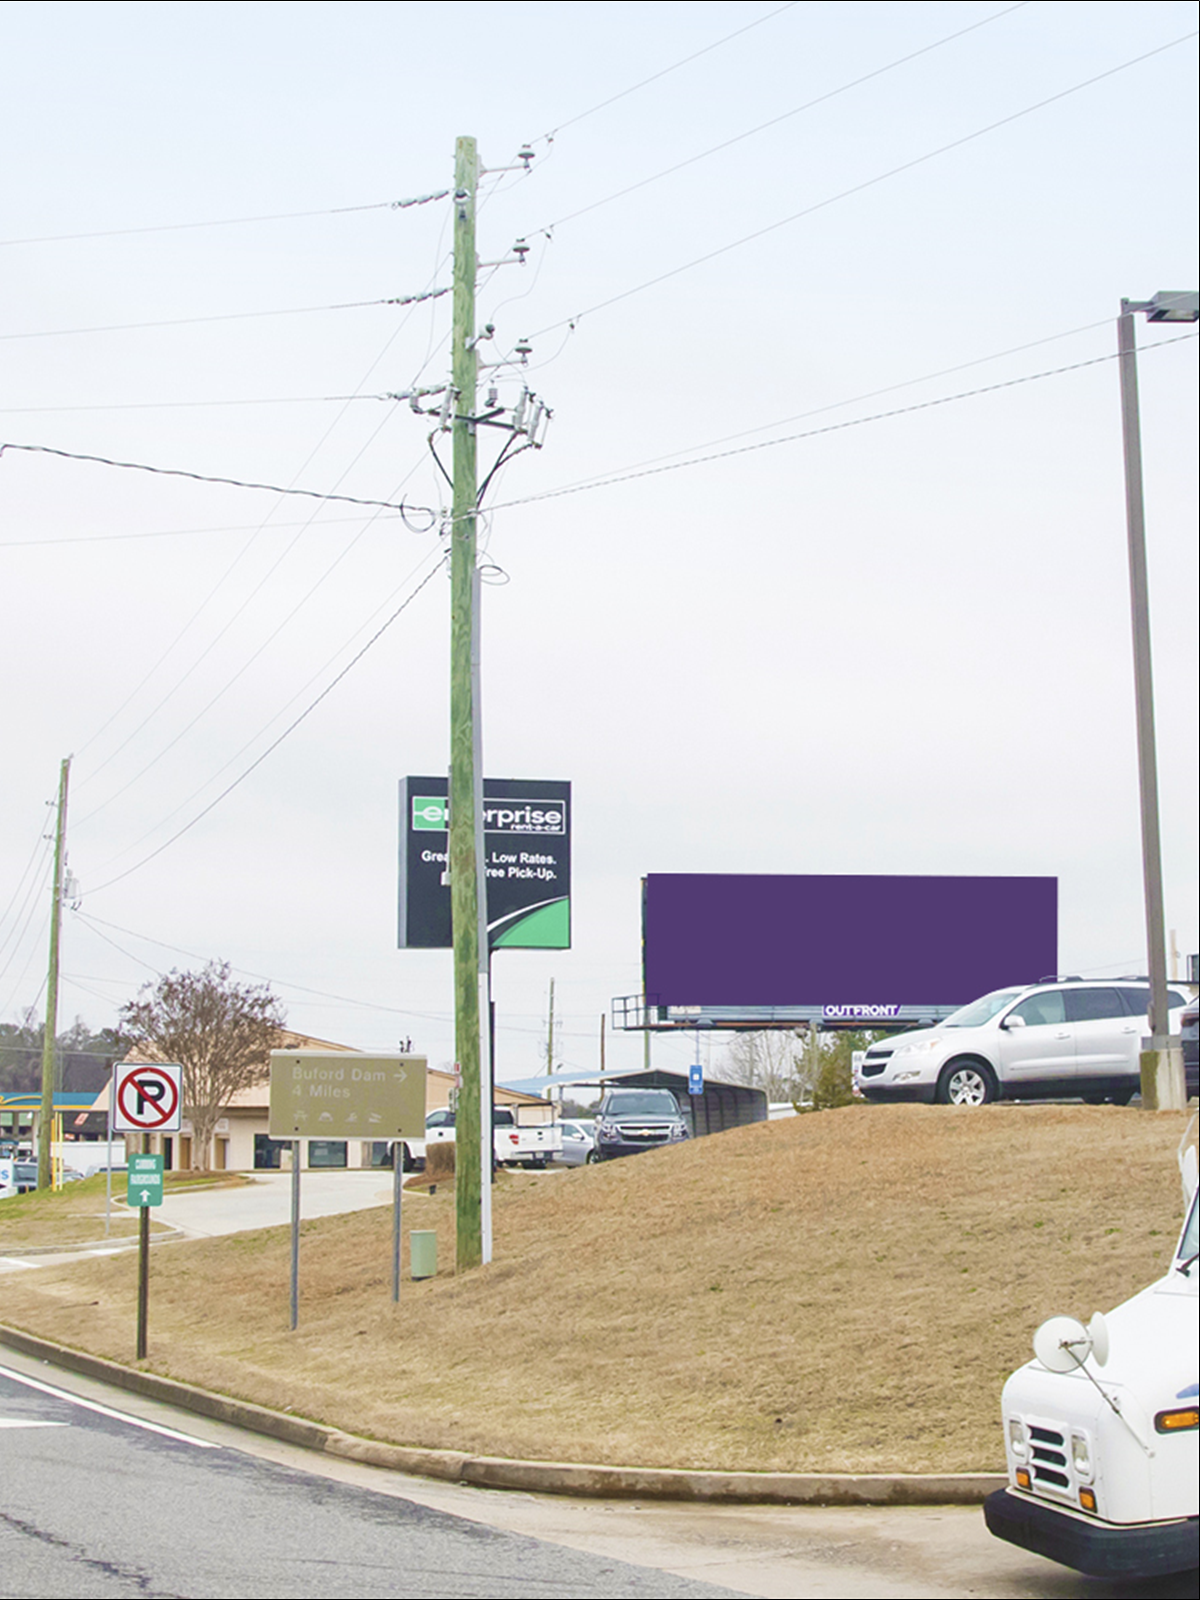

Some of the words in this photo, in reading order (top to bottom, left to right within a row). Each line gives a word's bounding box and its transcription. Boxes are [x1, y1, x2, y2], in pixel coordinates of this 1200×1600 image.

[414, 806, 561, 827] erprise
[492, 852, 518, 863] Low
[520, 852, 557, 864] Rates.
[484, 866, 505, 877] ree
[508, 866, 557, 881] Pick-Up.
[825, 1004, 898, 1016] OUTFRONT
[292, 1066, 345, 1080] Buford
[351, 1067, 386, 1082] Dam
[292, 1085, 301, 1097] 4
[309, 1085, 351, 1098] Miles
